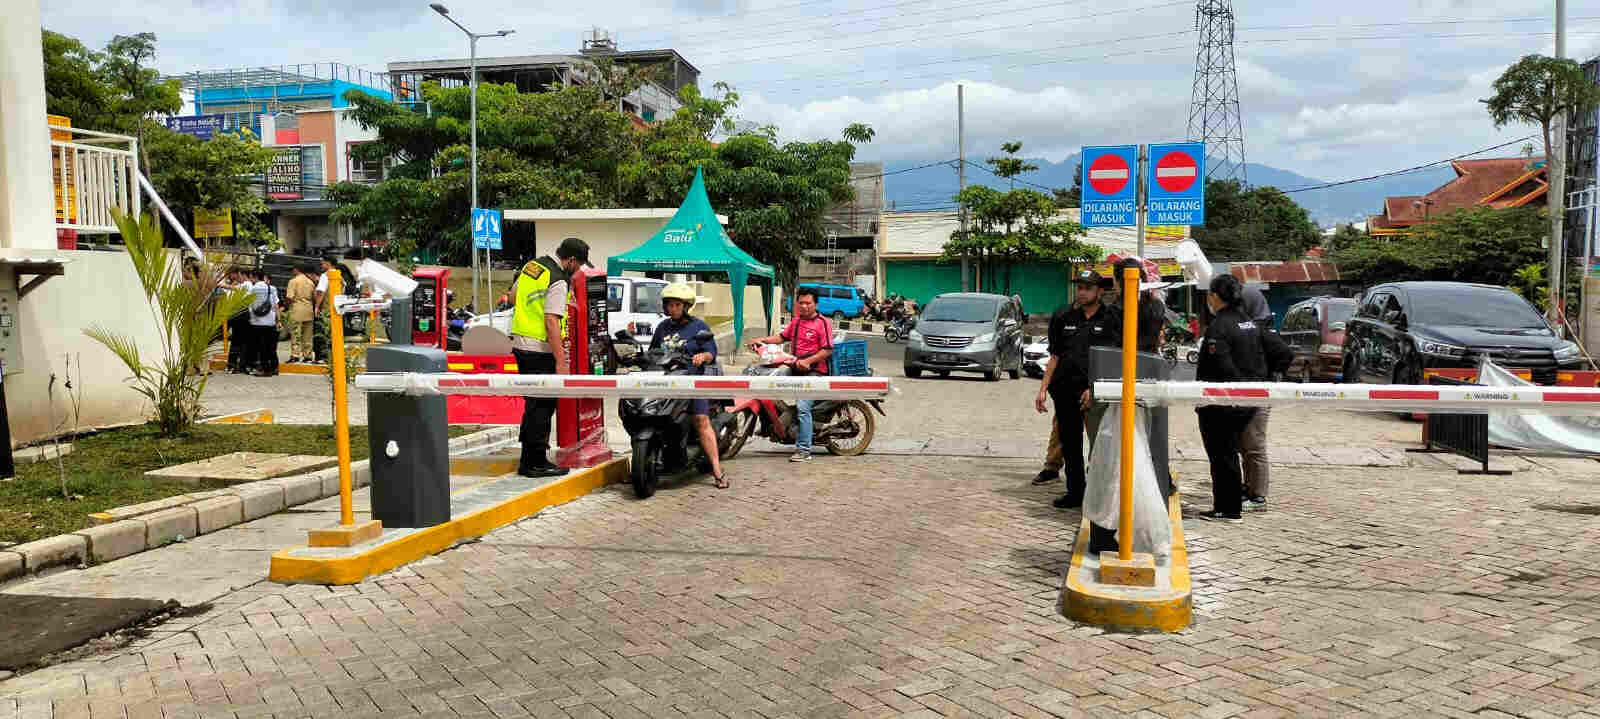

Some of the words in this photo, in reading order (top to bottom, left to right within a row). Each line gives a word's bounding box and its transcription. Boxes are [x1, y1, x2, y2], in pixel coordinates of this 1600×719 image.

[1084, 202, 1133, 213] DILARANG
[1151, 200, 1200, 211] DILARANG
[1091, 213, 1126, 224] MASUK
[1158, 211, 1192, 222] MASUK
[1472, 391, 1509, 400] WARNING
